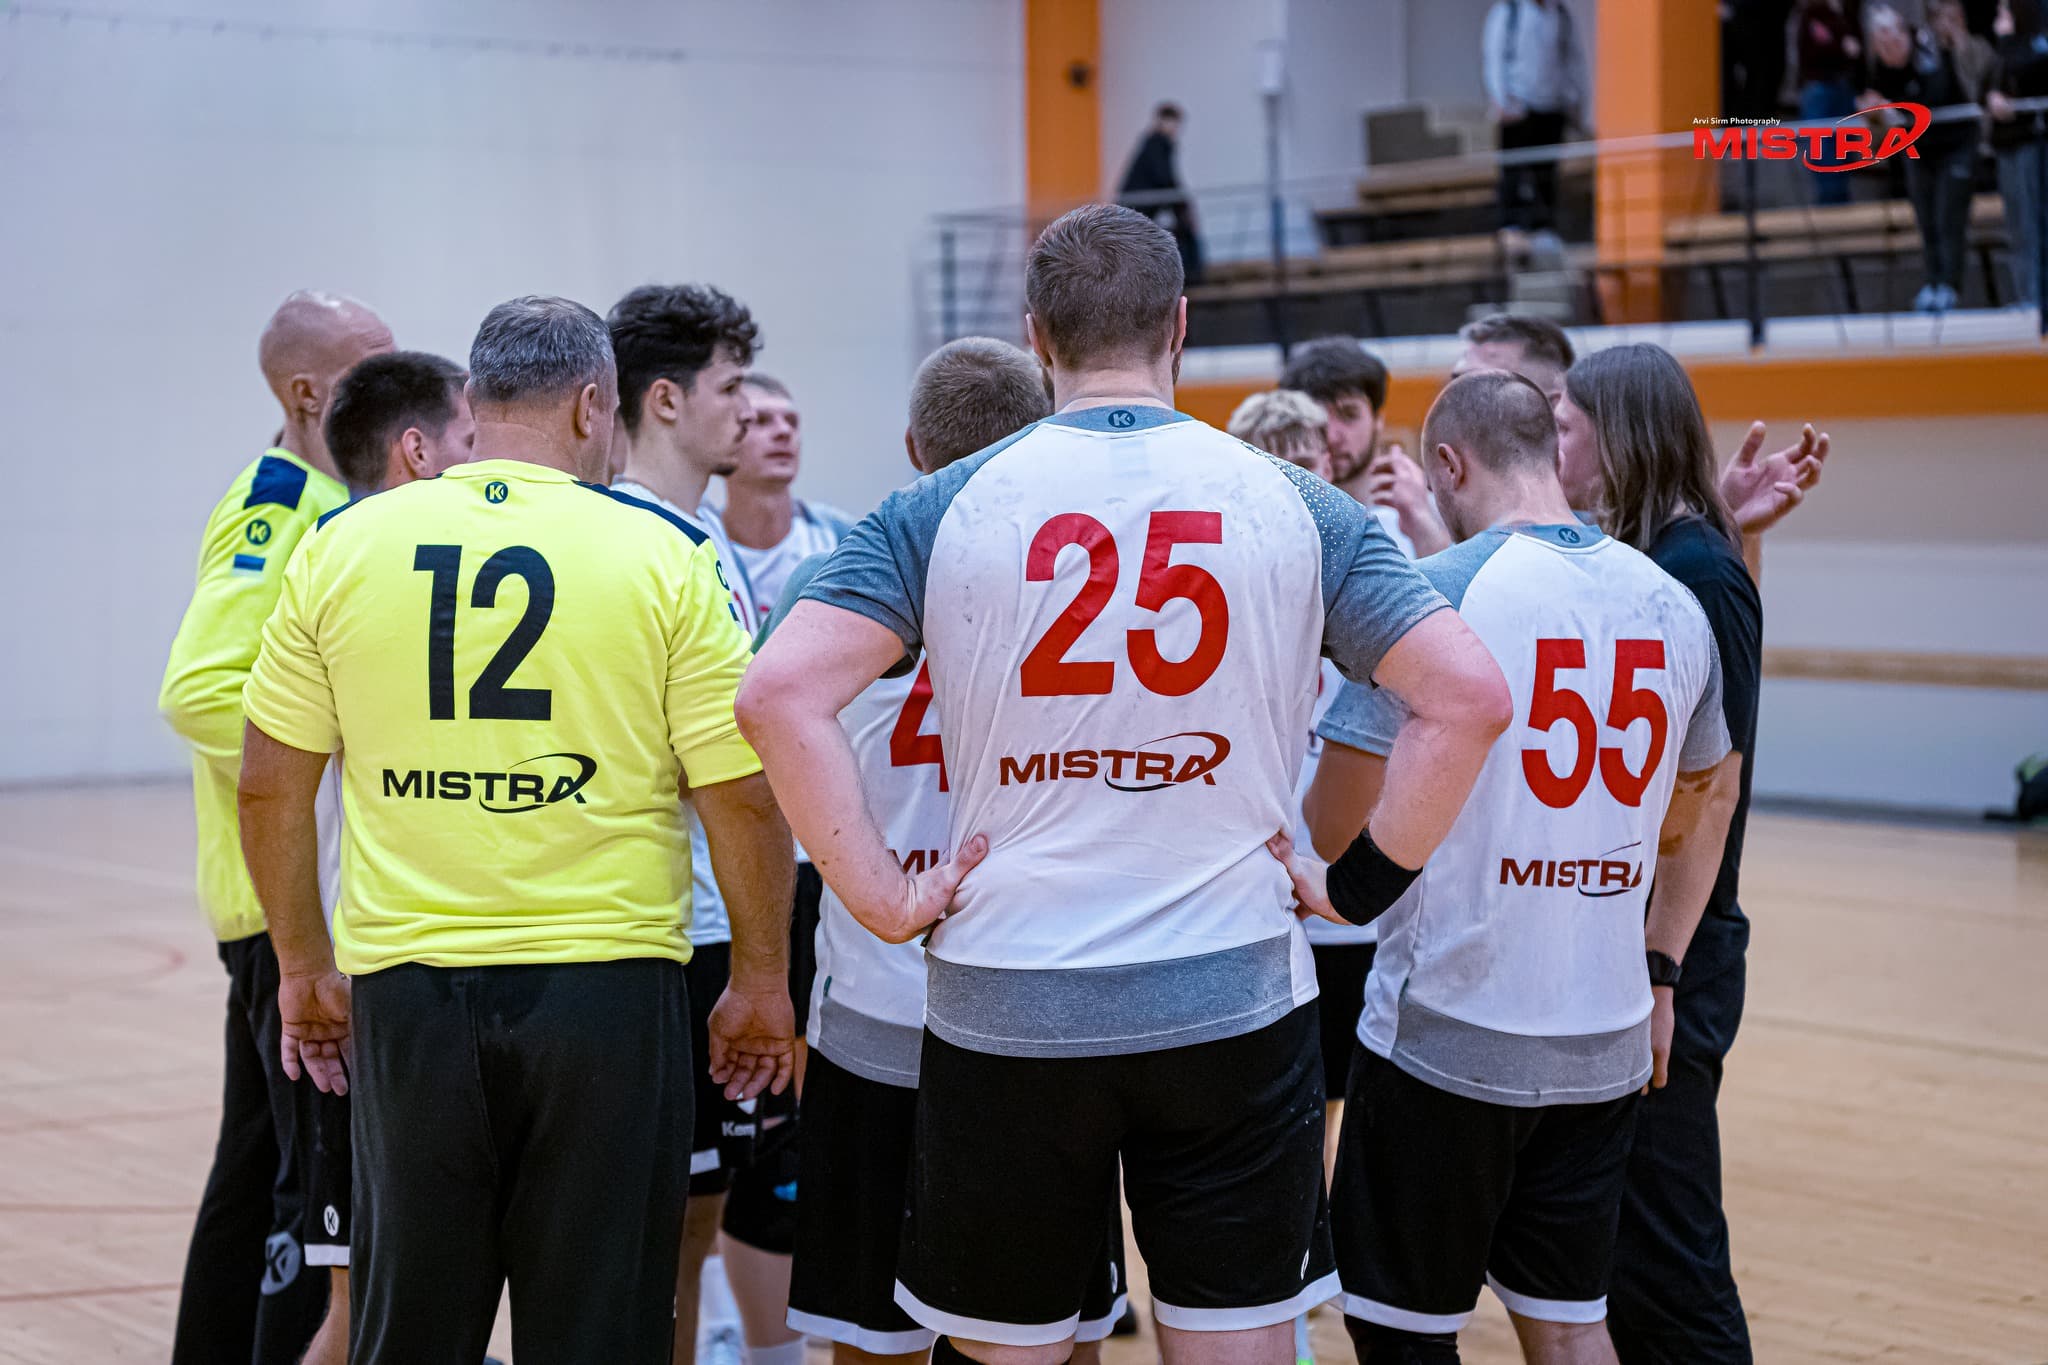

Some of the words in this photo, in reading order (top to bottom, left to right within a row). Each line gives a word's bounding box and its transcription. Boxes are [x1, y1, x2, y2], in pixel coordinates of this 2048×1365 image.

[413, 544, 556, 721] 12
[1020, 510, 1230, 698] 25
[382, 756, 597, 812] MISTRA
[1000, 736, 1228, 792] MISTRA
[1521, 638, 1668, 809] 55
